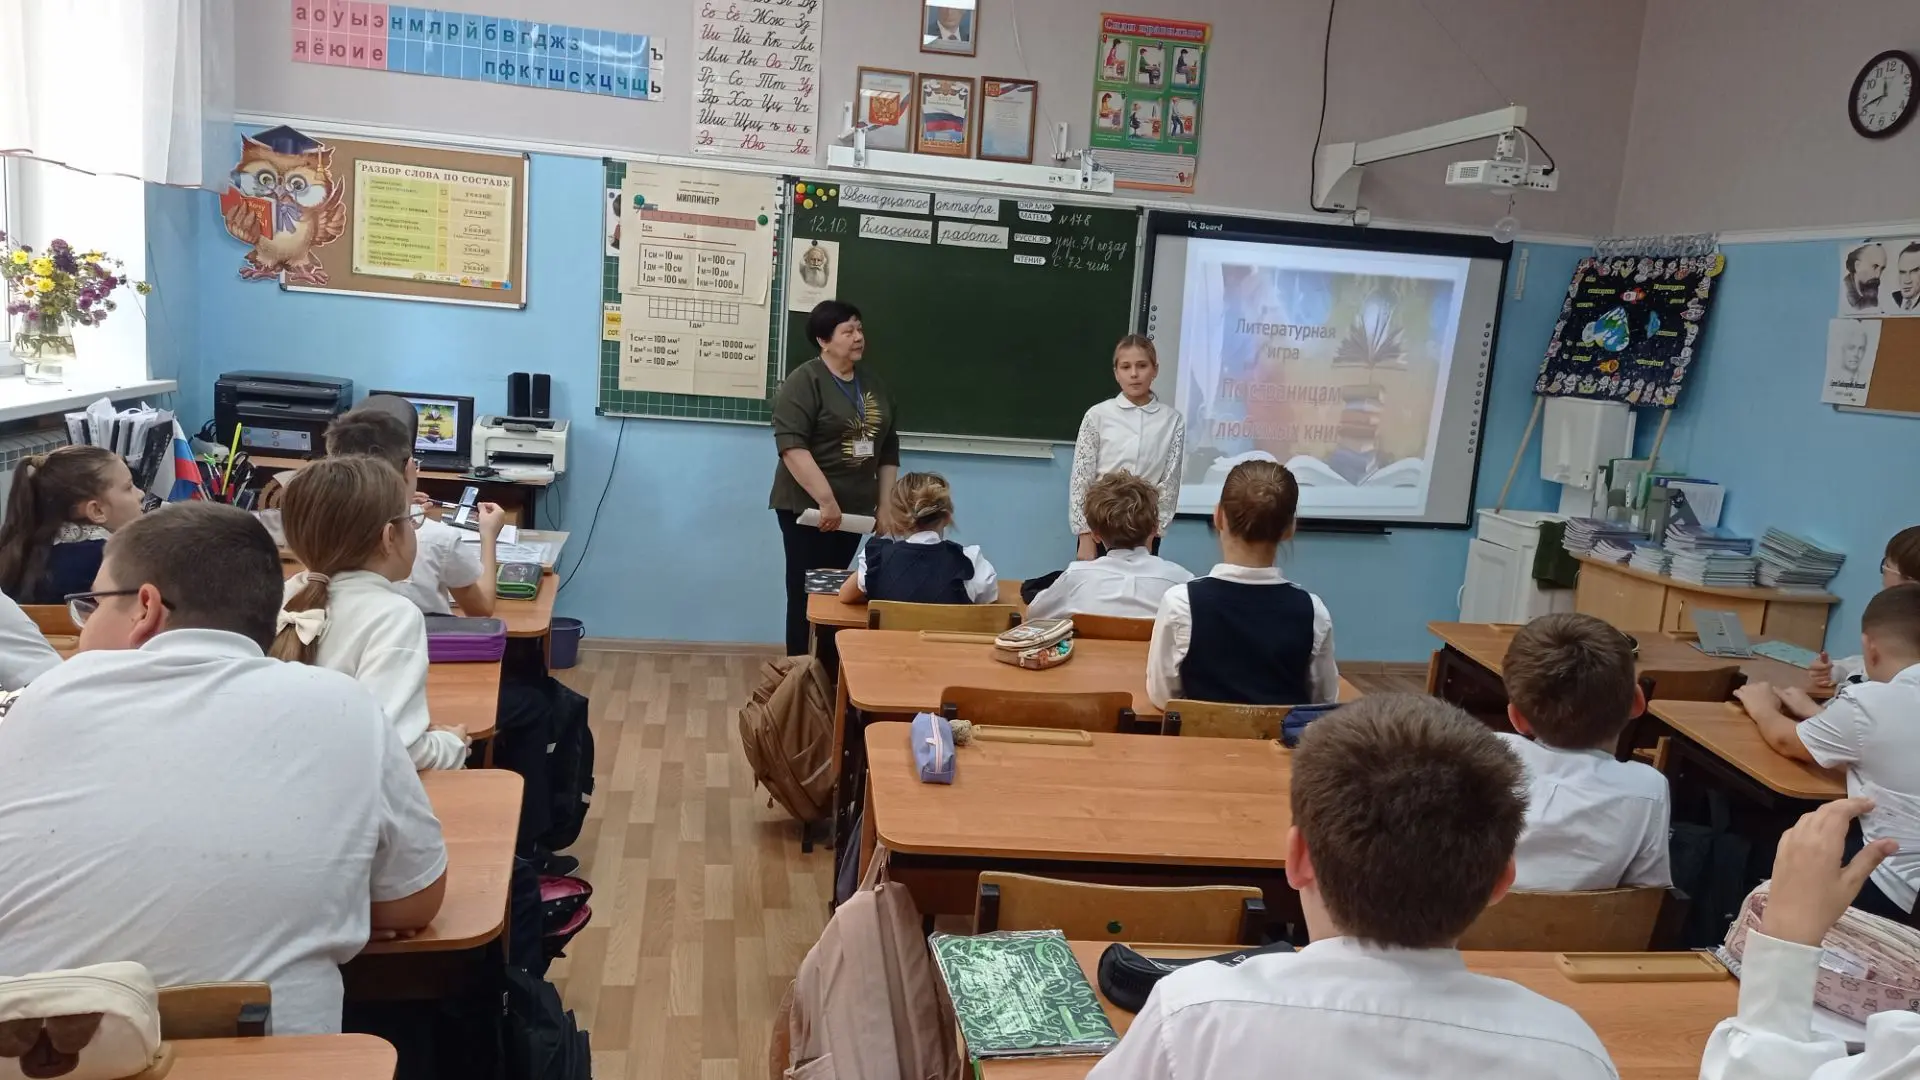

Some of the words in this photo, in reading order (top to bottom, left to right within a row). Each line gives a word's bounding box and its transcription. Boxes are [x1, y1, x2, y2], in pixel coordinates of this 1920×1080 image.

[1886, 61, 1896, 72] 12
[1866, 80, 1876, 90] 10
[361, 164, 402, 175] РАЗБОР
[405, 169, 440, 180] СЛОВА
[462, 176, 510, 187] СОСТАВУ
[841, 185, 928, 209] Двенадцатое
[860, 216, 930, 238] Классная
[1188, 220, 1197, 230] IQ
[1200, 223, 1223, 231] Board
[1015, 255, 1042, 264] ЧТЕНИЕ
[1235, 318, 1336, 341] Литературная
[1267, 346, 1300, 362] игра
[1249, 383, 1340, 406] страницам
